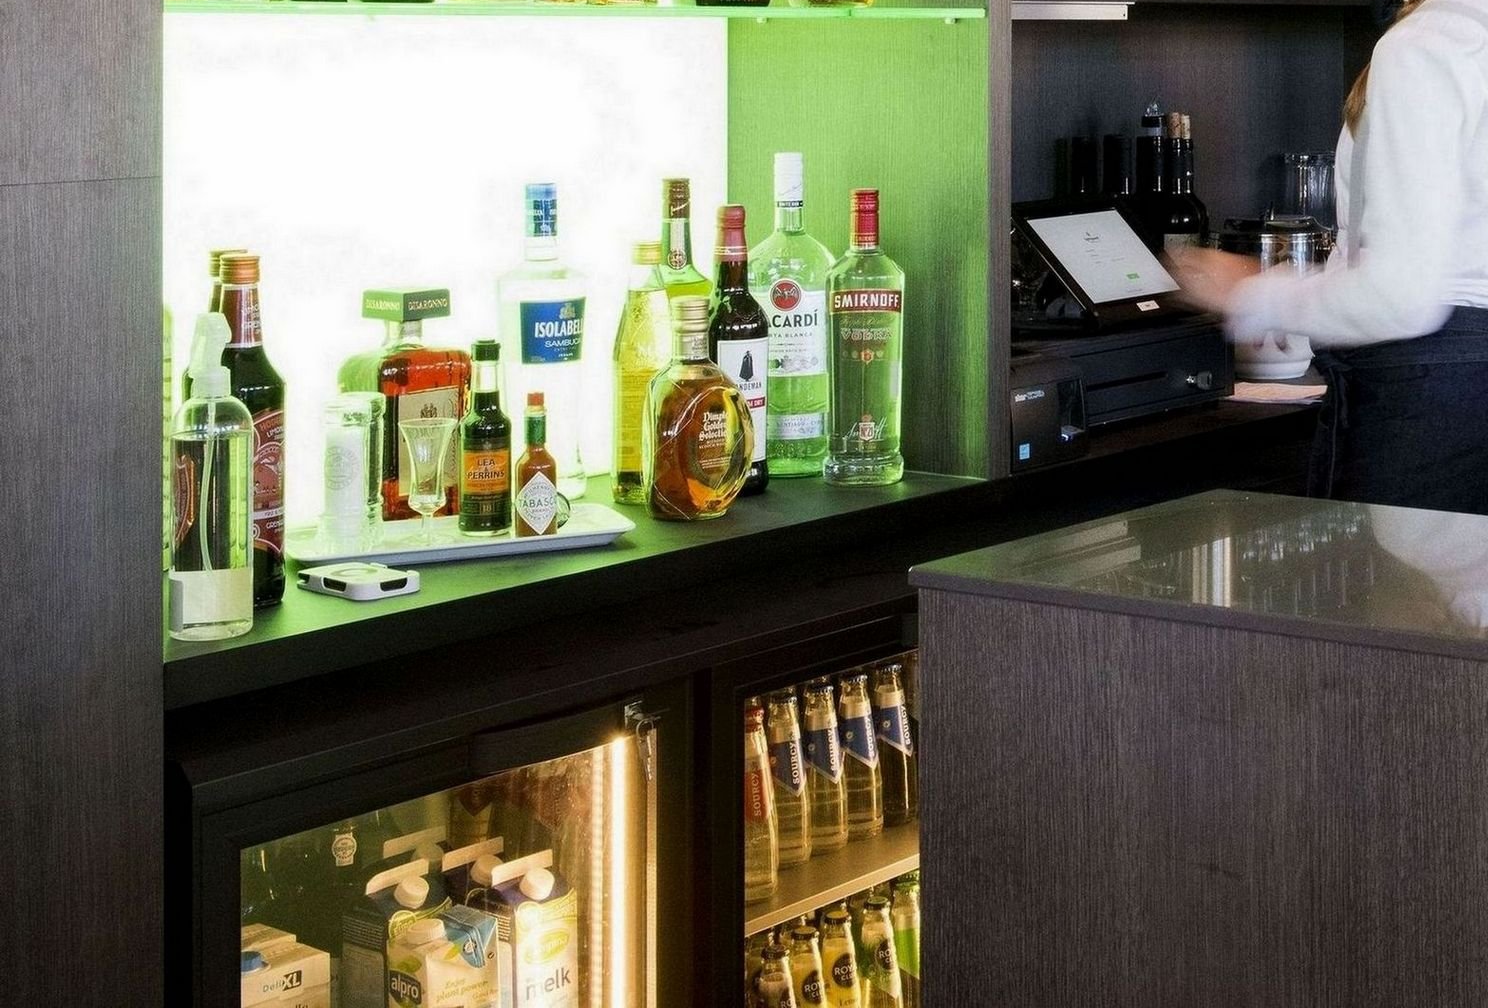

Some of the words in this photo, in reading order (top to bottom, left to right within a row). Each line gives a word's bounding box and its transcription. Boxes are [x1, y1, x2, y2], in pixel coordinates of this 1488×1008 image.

[834, 294, 900, 308] SMIRNOFF
[534, 319, 583, 338] ISOLABELL
[544, 337, 581, 348] SAMBUC
[476, 458, 496, 467] LEA
[466, 471, 506, 480] PERRINS
[789, 741, 800, 785] SOURCY
[751, 772, 762, 817] SOURCY
[391, 976, 420, 1000] alpro
